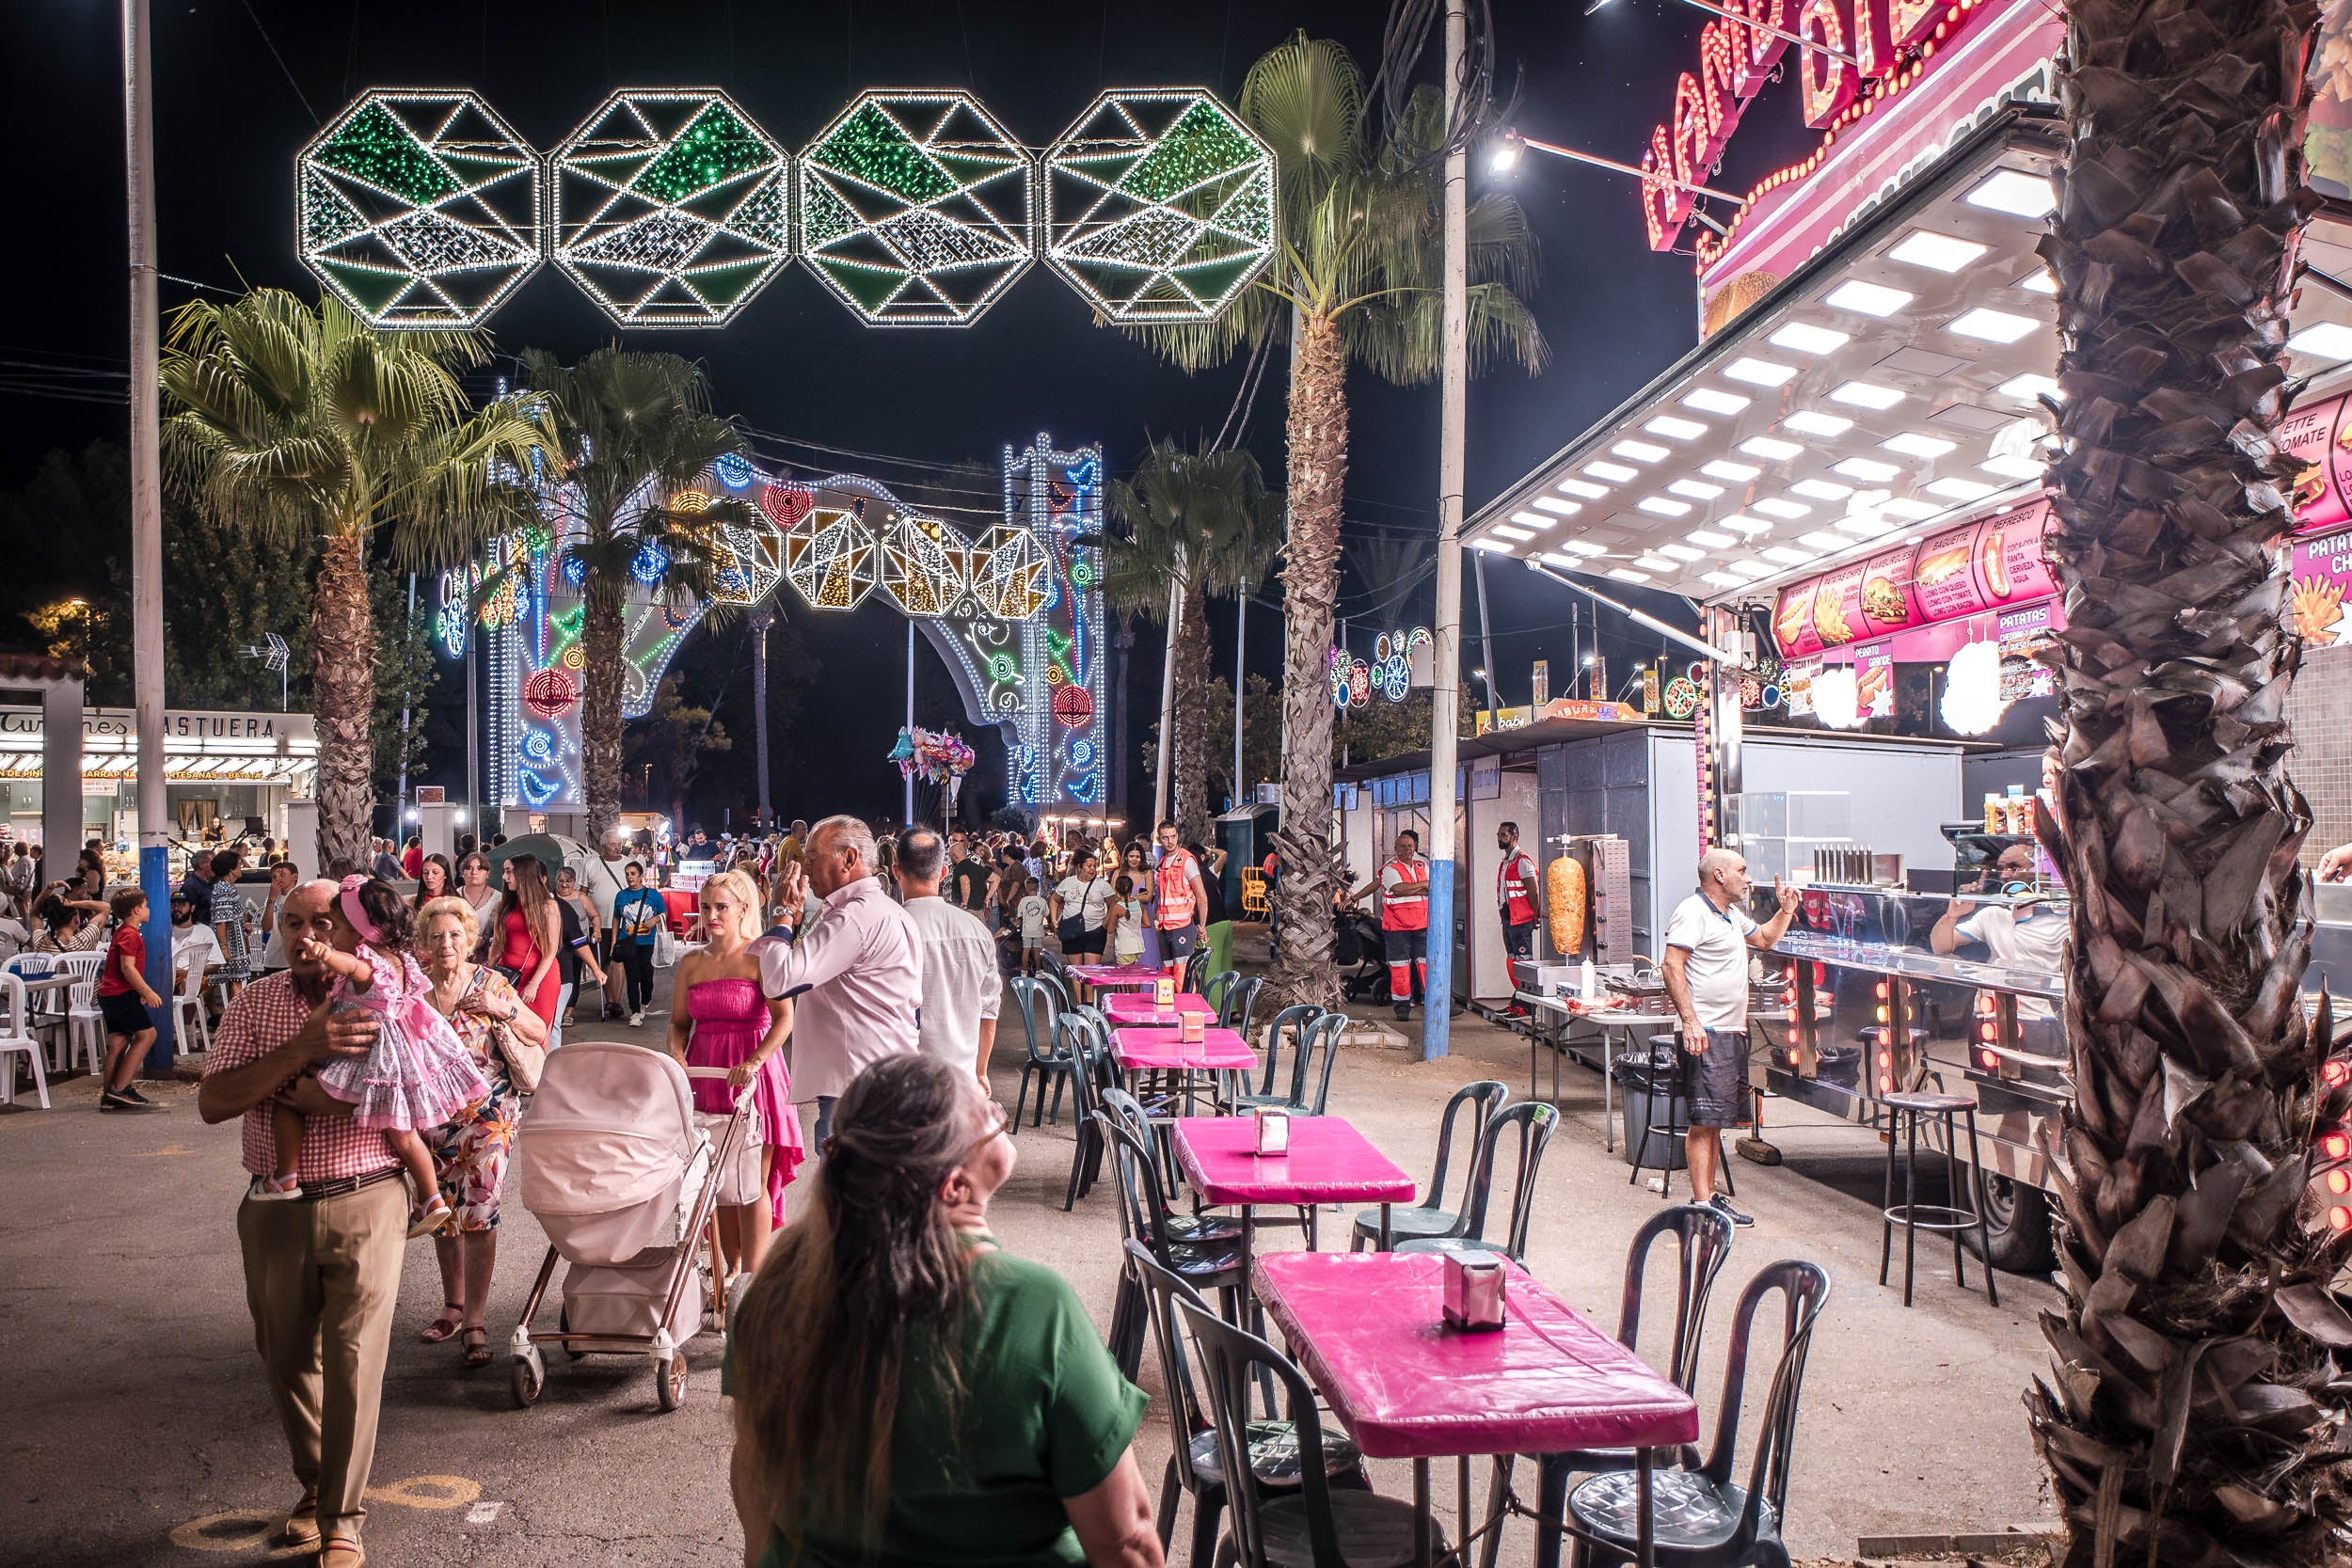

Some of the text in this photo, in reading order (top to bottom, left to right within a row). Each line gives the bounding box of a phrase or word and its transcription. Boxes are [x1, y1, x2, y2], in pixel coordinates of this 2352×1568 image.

[2283, 412, 2317, 435] ETTE
[2280, 426, 2327, 451] OMATE
[1992, 509, 2036, 531] REFRESCO
[1931, 531, 1971, 551] BAGUETTE
[2007, 536, 2039, 553] COCA-COLA
[1869, 548, 1915, 571] HAMBURGUESA
[2007, 553, 2025, 563] FANTA
[1823, 566, 1864, 586] PATATAS CHIPS
[2009, 561, 2035, 574] CERVEZA
[2012, 574, 2030, 584] AGUA
[1788, 584, 1810, 599] PERRITO
[1924, 580, 1966, 598] LOMO CON QUESO
[1927, 590, 1973, 608] LOMO CON TOMATE
[1957, 599, 1975, 611] BACON
[1999, 607, 2047, 629] PATATAS
[1854, 644, 1880, 658] PERRITO
[1867, 654, 1892, 668] GRANDE
[165, 716, 276, 738] ASTUERA
[1482, 713, 1526, 734] Kbabs
